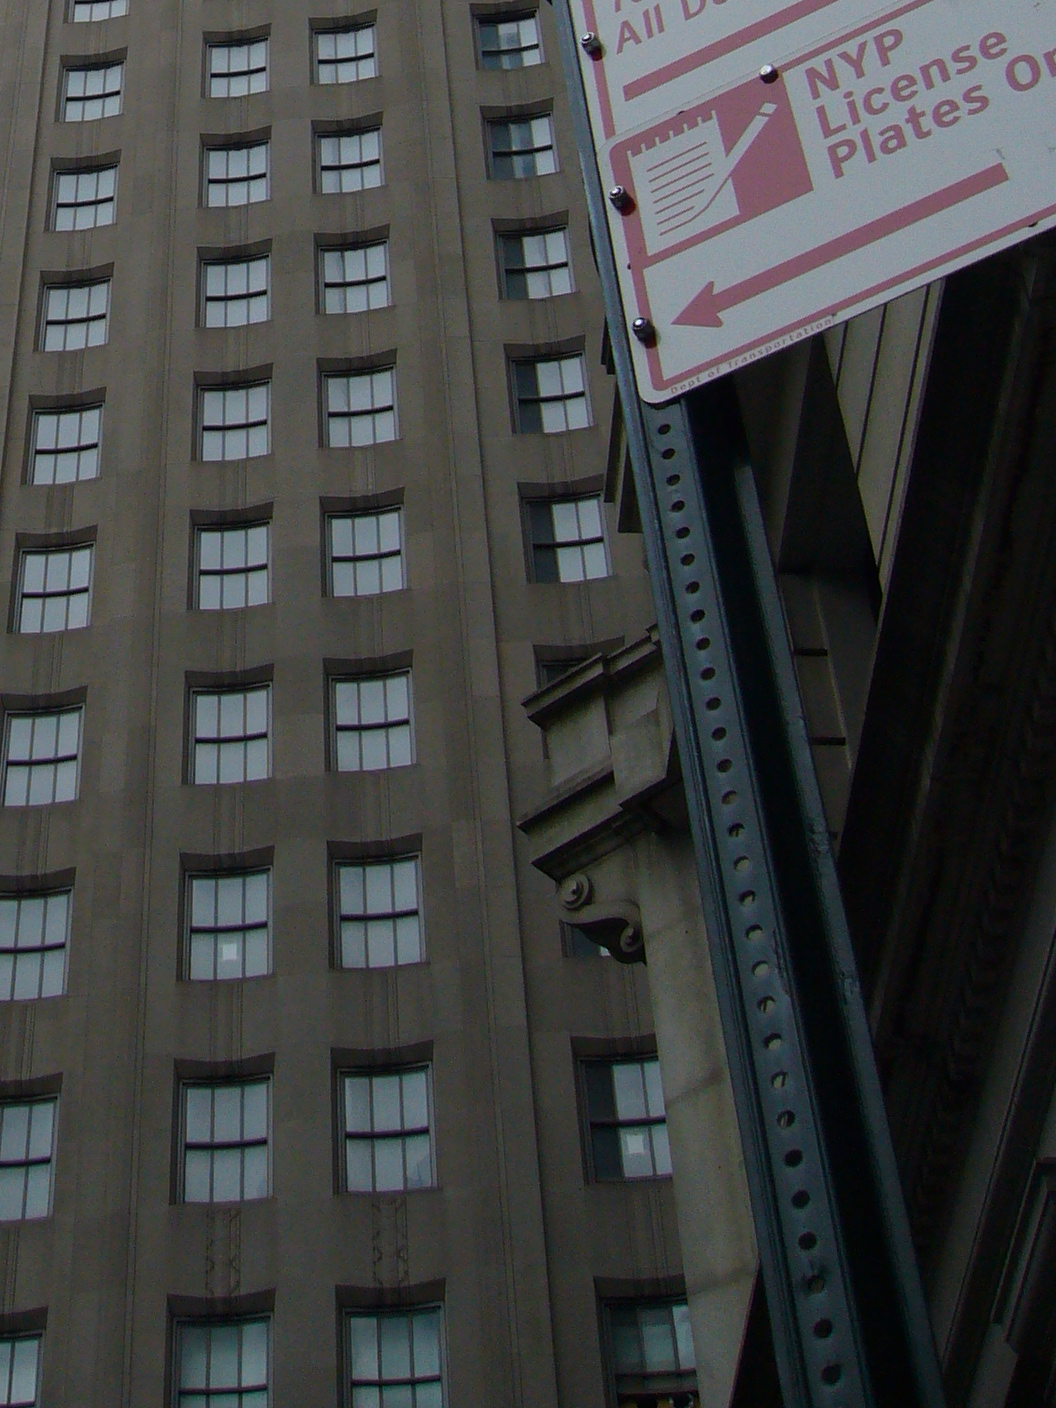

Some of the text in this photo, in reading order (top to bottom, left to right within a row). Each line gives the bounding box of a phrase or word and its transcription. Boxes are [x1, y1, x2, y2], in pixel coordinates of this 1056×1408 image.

[616, 3, 665, 54] All
[804, 29, 904, 100] NYP
[816, 31, 1008, 140] License
[828, 84, 990, 179] Plates
[670, 317, 833, 394] Dept of Transportation
